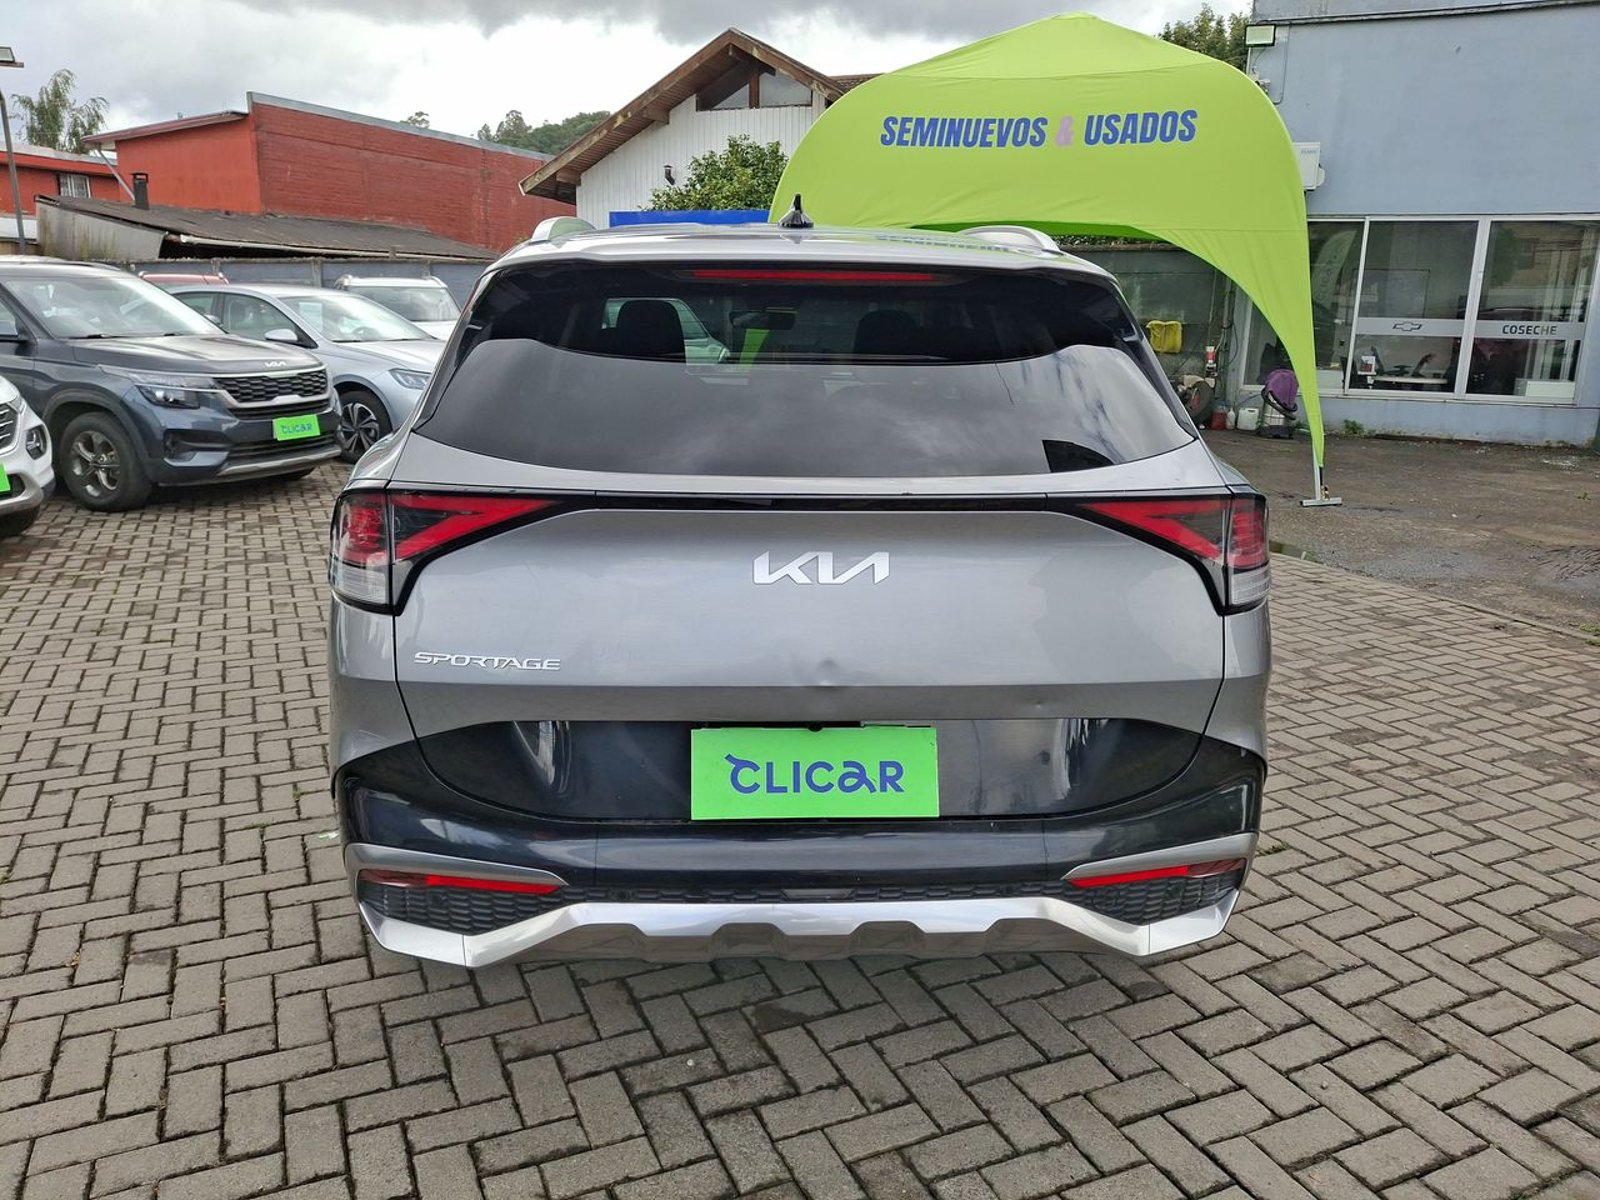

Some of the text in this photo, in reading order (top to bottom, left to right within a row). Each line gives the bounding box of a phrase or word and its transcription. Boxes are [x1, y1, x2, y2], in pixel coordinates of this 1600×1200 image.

[880, 110, 1197, 147] SEMINUEVOS & USADOS
[1502, 324, 1557, 335] COSECHE
[753, 551, 890, 585] KIA
[414, 651, 561, 670] SPORTAGE
